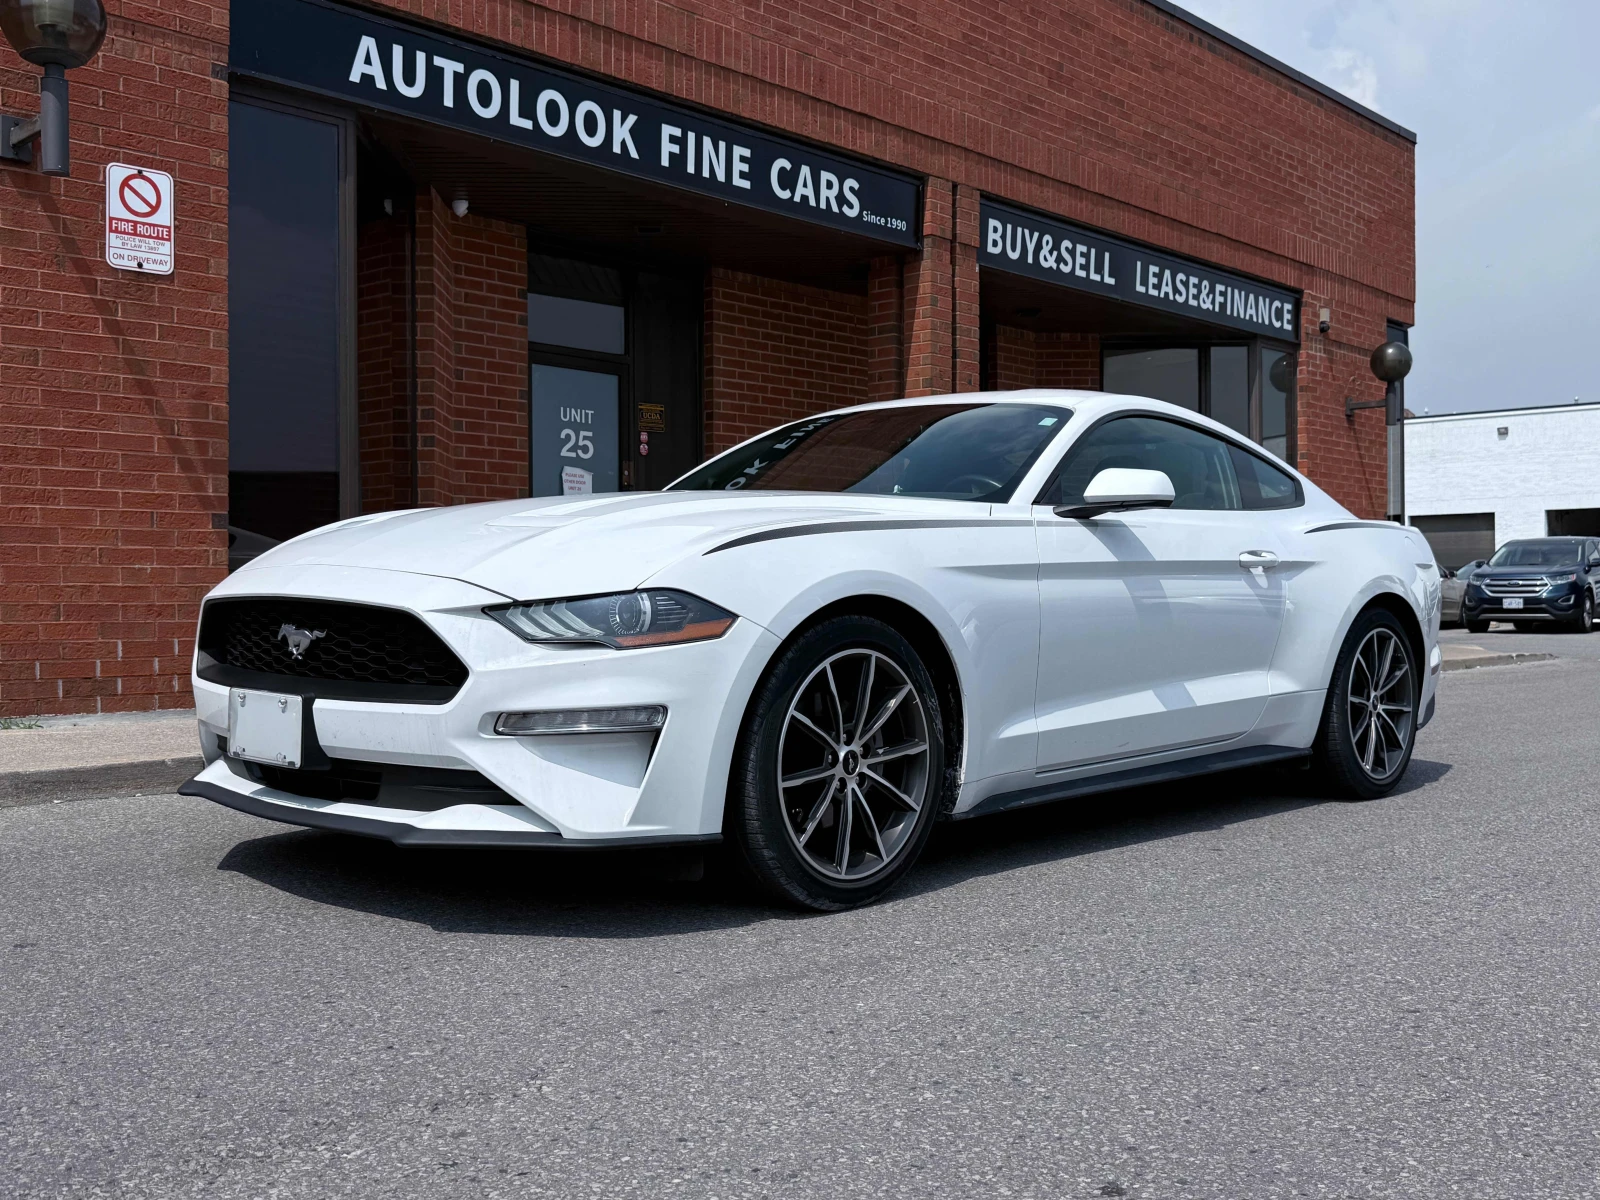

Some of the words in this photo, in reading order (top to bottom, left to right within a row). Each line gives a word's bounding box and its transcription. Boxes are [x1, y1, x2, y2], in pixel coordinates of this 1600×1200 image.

[349, 35, 640, 160] AUTOLOOK
[660, 123, 752, 190] FINE
[770, 157, 861, 218] CARS
[112, 220, 134, 233] FIRE
[137, 224, 169, 239] ROUTE
[862, 210, 886, 226] Since
[886, 217, 907, 231] 1990
[115, 235, 136, 243] POLICE
[112, 252, 125, 261] ON
[127, 254, 169, 266] DRIVEWAY
[986, 217, 1116, 286] BUY&SELL
[1135, 260, 1293, 331] LEASE&FINANCE
[560, 406, 595, 425] UNIT
[643, 412, 661, 420] UCDA
[560, 428, 595, 460] 25
